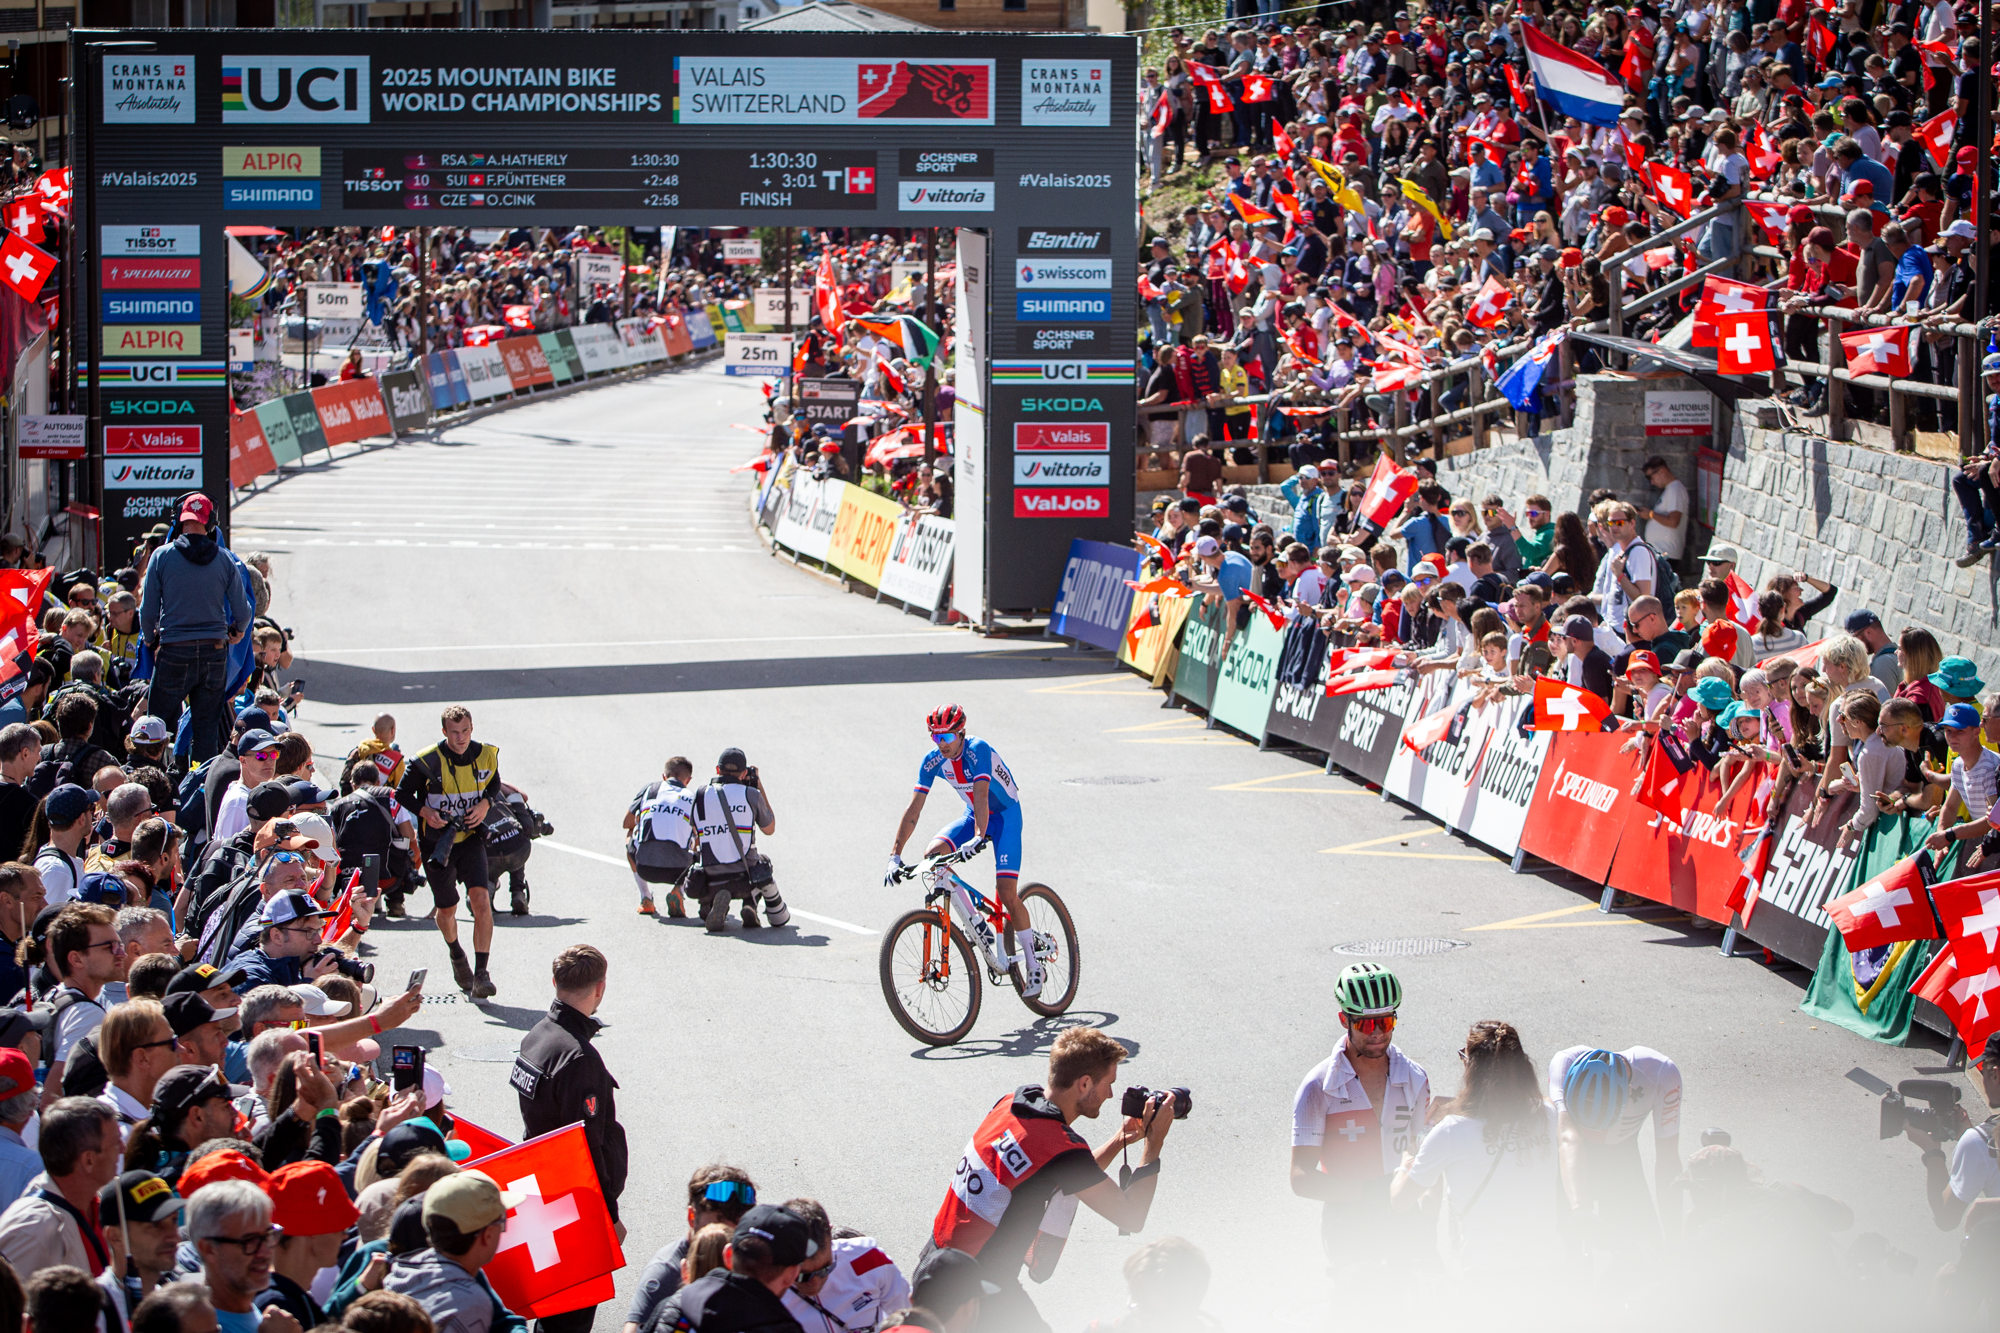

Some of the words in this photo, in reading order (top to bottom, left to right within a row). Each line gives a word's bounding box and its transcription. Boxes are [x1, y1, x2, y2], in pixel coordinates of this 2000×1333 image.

[112, 64, 162, 77] CRANS
[382, 68, 436, 87] 2025
[438, 68, 562, 87] MOUNTAIN
[568, 68, 616, 87] BIKE
[691, 67, 766, 87] VALAIS
[1030, 68, 1079, 80] CRANS
[112, 78, 187, 91] MONTANA
[247, 67, 358, 112] UCI
[1030, 81, 1102, 94] MONTANA
[115, 93, 181, 114] Absolutely
[382, 92, 465, 113] WORLD
[468, 93, 661, 113] CHAMPIONSHIPS
[691, 93, 847, 114] SWITZERLAND
[1033, 96, 1098, 117] Absolutely
[242, 153, 302, 173] ALPIQ
[417, 154, 425, 167] 1
[441, 154, 468, 167] RSA
[486, 154, 568, 167] A.HATHERLY
[631, 154, 680, 167] 1:30:30
[749, 153, 817, 168] 1:30:30
[919, 153, 978, 163] OCHSNER
[916, 163, 956, 173] SPORT
[102, 172, 198, 187] #Valais2025
[344, 180, 403, 192] TISSOT
[412, 174, 430, 187] 10
[446, 174, 468, 187] SUI
[487, 171, 566, 187] F.PÜNTENER
[642, 174, 680, 187] +2:48
[782, 174, 817, 188] 3:01
[1019, 173, 1112, 189] #Valais2025
[230, 187, 314, 202] SHIMANO
[413, 194, 430, 207] 11
[440, 194, 467, 207] CZE
[486, 194, 536, 207] O.CINK
[642, 194, 680, 207] +2:58
[740, 192, 792, 207] FINISH
[926, 187, 986, 205] vittoria
[125, 238, 176, 248] TISSOT
[1027, 231, 1101, 249] Santini
[122, 269, 191, 279] SPECIALIZED
[1037, 266, 1107, 280] swisscom
[317, 293, 349, 305] 50m
[1022, 300, 1105, 313] SHIMANO
[109, 301, 194, 314] SHIMANO
[121, 329, 184, 351] ALPIQ
[1036, 330, 1095, 340] OCHSNER
[1033, 339, 1073, 350] SPORT
[741, 347, 778, 361] 25m
[131, 366, 172, 382] UCI
[1044, 364, 1082, 380] UCI
[806, 405, 852, 419] START
[1669, 403, 1710, 411] AUTOBUS
[44, 423, 84, 431] AUTOBUS
[142, 432, 184, 446] Valais
[1050, 430, 1092, 444] Valais
[131, 465, 195, 481] vittoria
[1042, 462, 1102, 477] vittoria
[1022, 496, 1101, 511] ValJob
[123, 506, 163, 518] SPORT
[850, 509, 896, 577] ALPIQ
[1055, 557, 1135, 630] SHIMANO
[1339, 700, 1386, 753] SPORT
[1481, 729, 1539, 808] vittoria
[1556, 771, 1619, 813] SPECIALIZED
[650, 804, 684, 817] STAFF
[704, 823, 730, 836] STAF
[999, 1136, 1027, 1173] UCI
[956, 1155, 984, 1195] OTO
